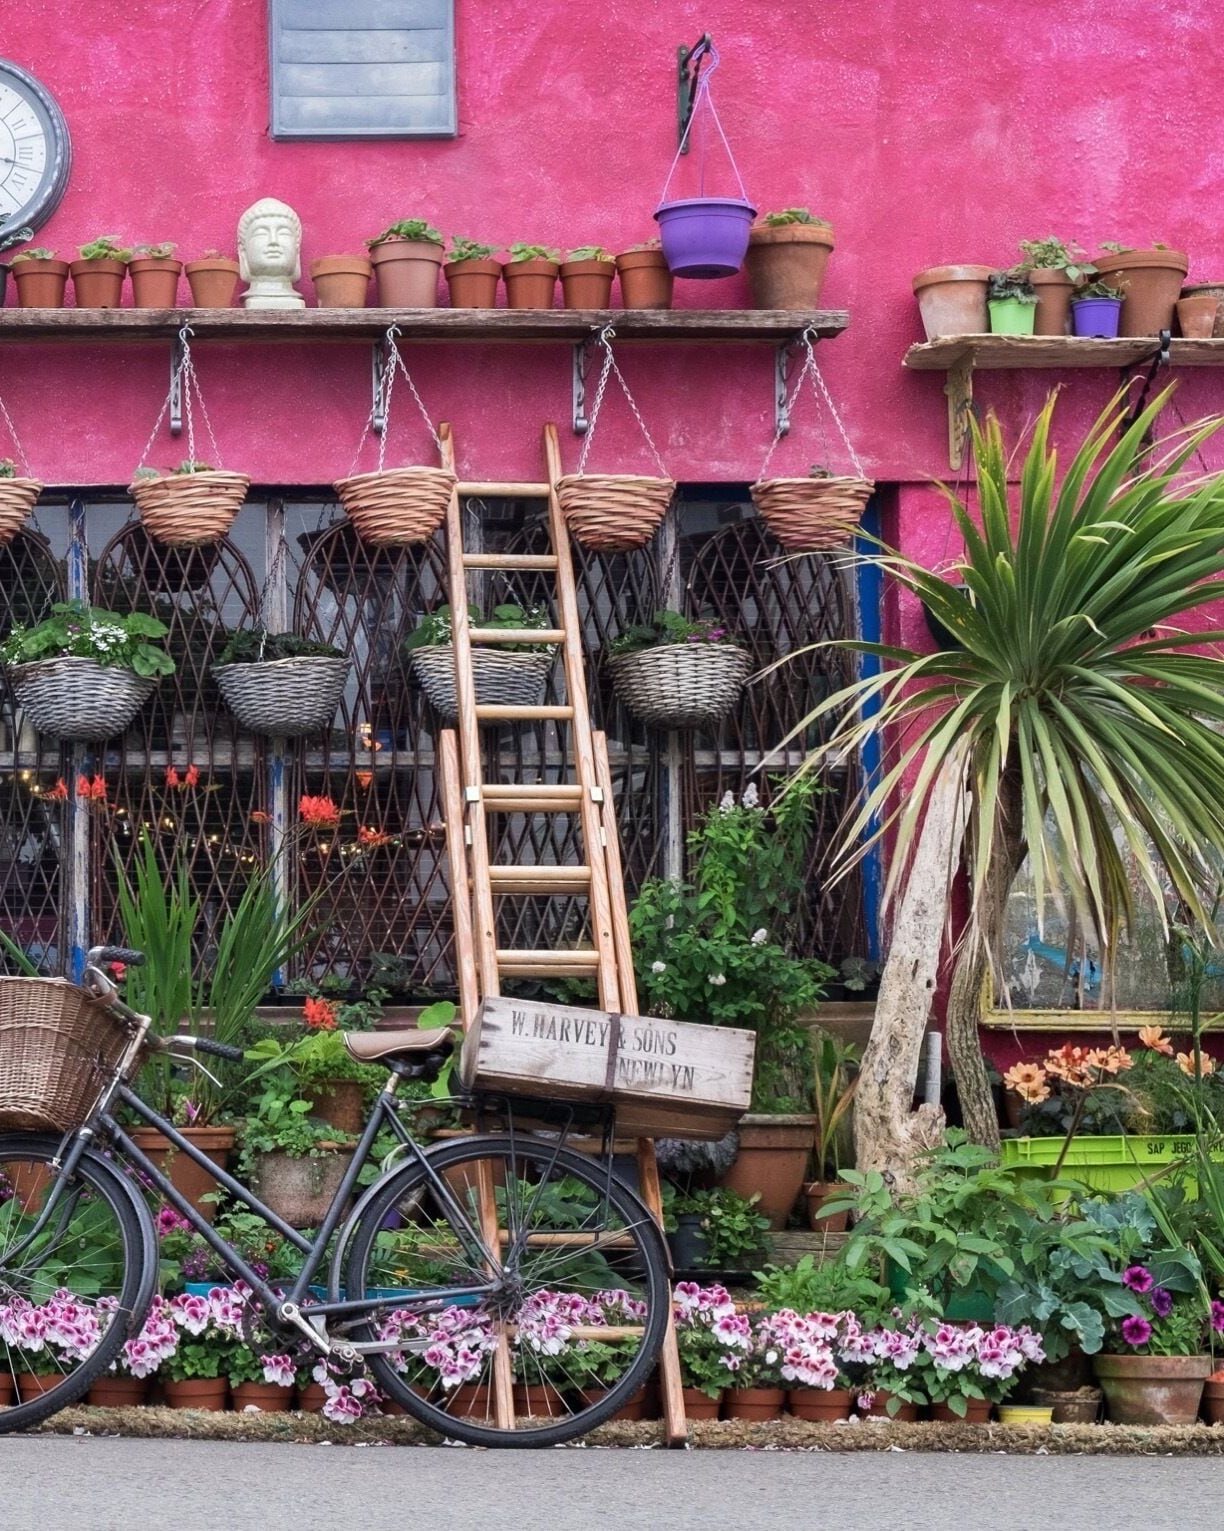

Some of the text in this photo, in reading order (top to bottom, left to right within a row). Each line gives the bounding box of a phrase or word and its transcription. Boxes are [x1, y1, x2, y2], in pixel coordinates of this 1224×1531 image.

[11, 119, 26, 131] II
[11, 172, 27, 192] IV
[633, 1027, 677, 1056] SONS
[619, 1056, 694, 1091] NEWLYN
[1147, 1142, 1165, 1155] SAP
